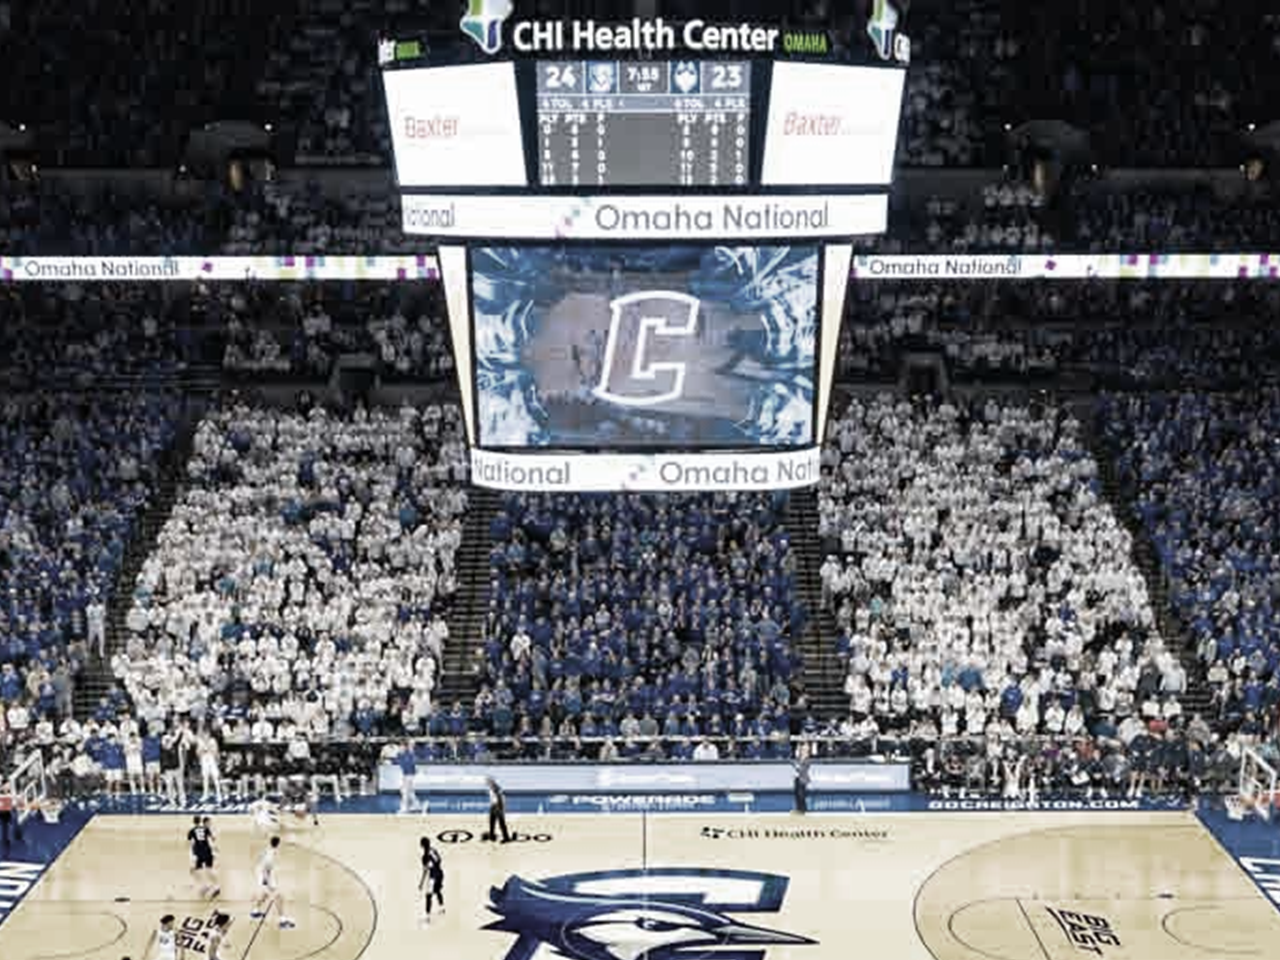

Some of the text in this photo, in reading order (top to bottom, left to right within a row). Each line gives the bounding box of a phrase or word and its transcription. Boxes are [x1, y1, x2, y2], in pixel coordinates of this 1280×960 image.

[513, 18, 827, 53] CHI Health Center OMAHA
[545, 65, 576, 88] 24
[711, 65, 743, 88] 23
[404, 116, 458, 138] Baxter
[784, 112, 842, 135] Baxter
[596, 202, 830, 231] Omaha National
[25, 258, 179, 277] Omaha National
[870, 256, 1021, 276] Omaha National
[660, 461, 769, 484] Omaha
[573, 794, 715, 805] POWERADE
